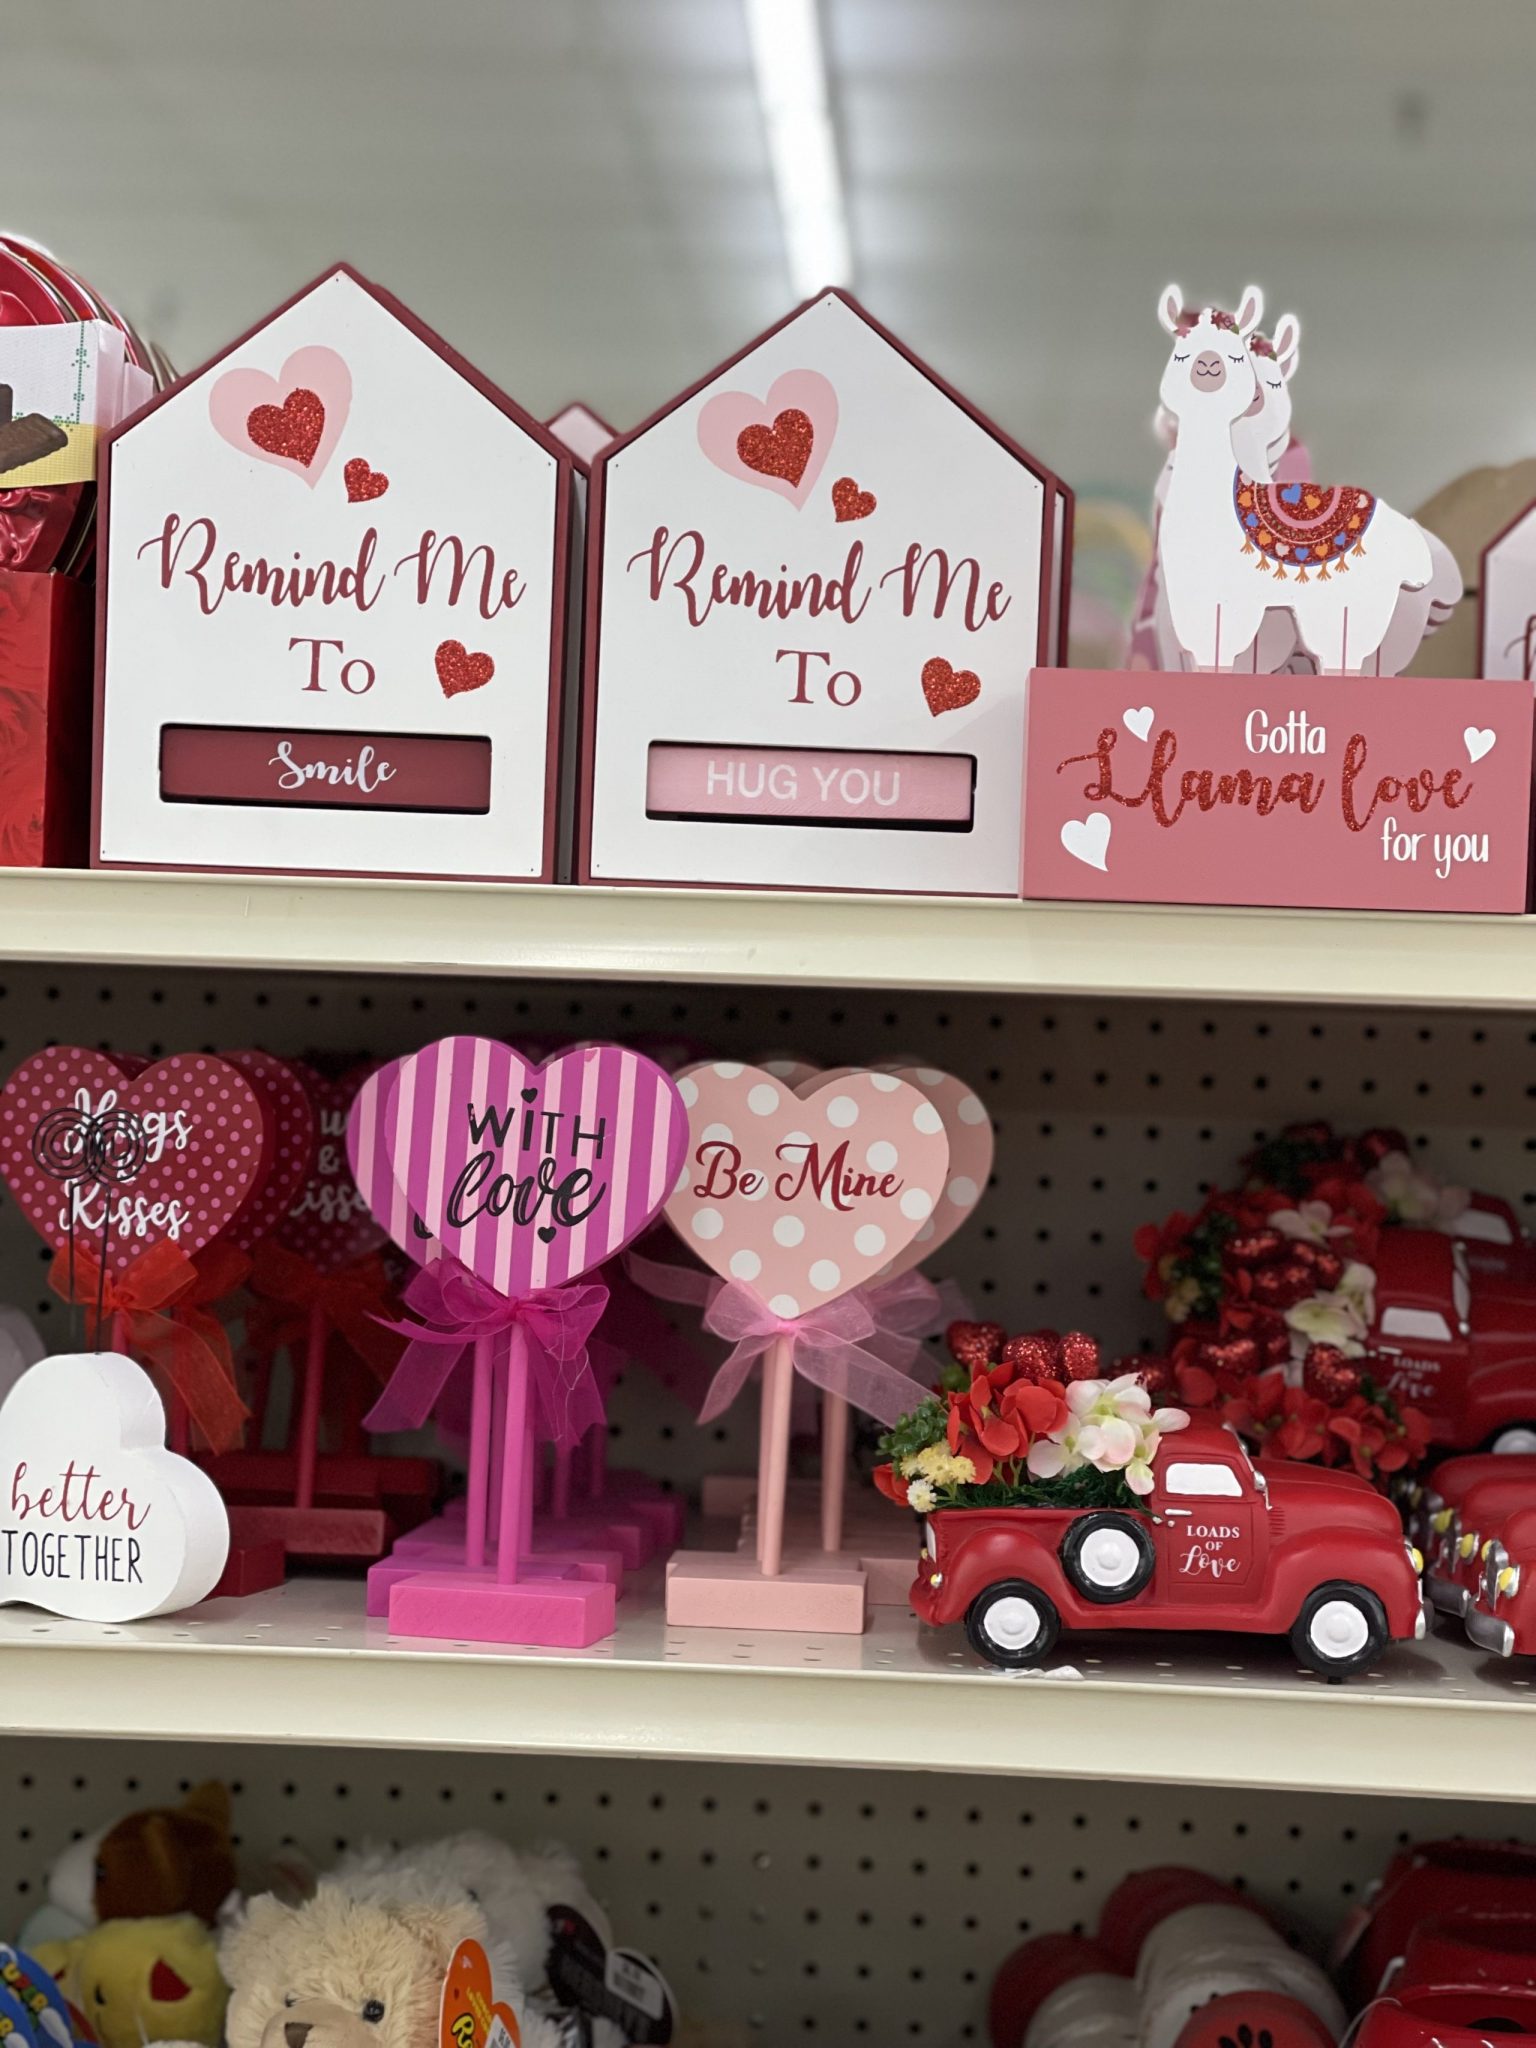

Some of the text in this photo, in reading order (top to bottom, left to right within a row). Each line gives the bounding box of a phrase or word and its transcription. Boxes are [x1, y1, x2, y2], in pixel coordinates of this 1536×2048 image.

[138, 514, 527, 620] Remind Me
[626, 526, 1012, 632] Remind Me
[288, 637, 376, 695] To
[775, 650, 862, 707] To
[1245, 709, 1326, 755] Gotta
[268, 741, 397, 793] Smile
[706, 760, 901, 807] HUG YOU
[1056, 728, 1325, 828] Llama
[1380, 817, 1489, 879] for you
[693, 1140, 905, 1212] Be Mine
[58, 1178, 190, 1241] Kisses
[10, 1460, 151, 1530] better
[1, 1530, 143, 1583] TOGETHER
[1186, 1525, 1240, 1538] LOADS
[1205, 1541, 1223, 1551] OF
[1179, 1545, 1241, 1578] Love
